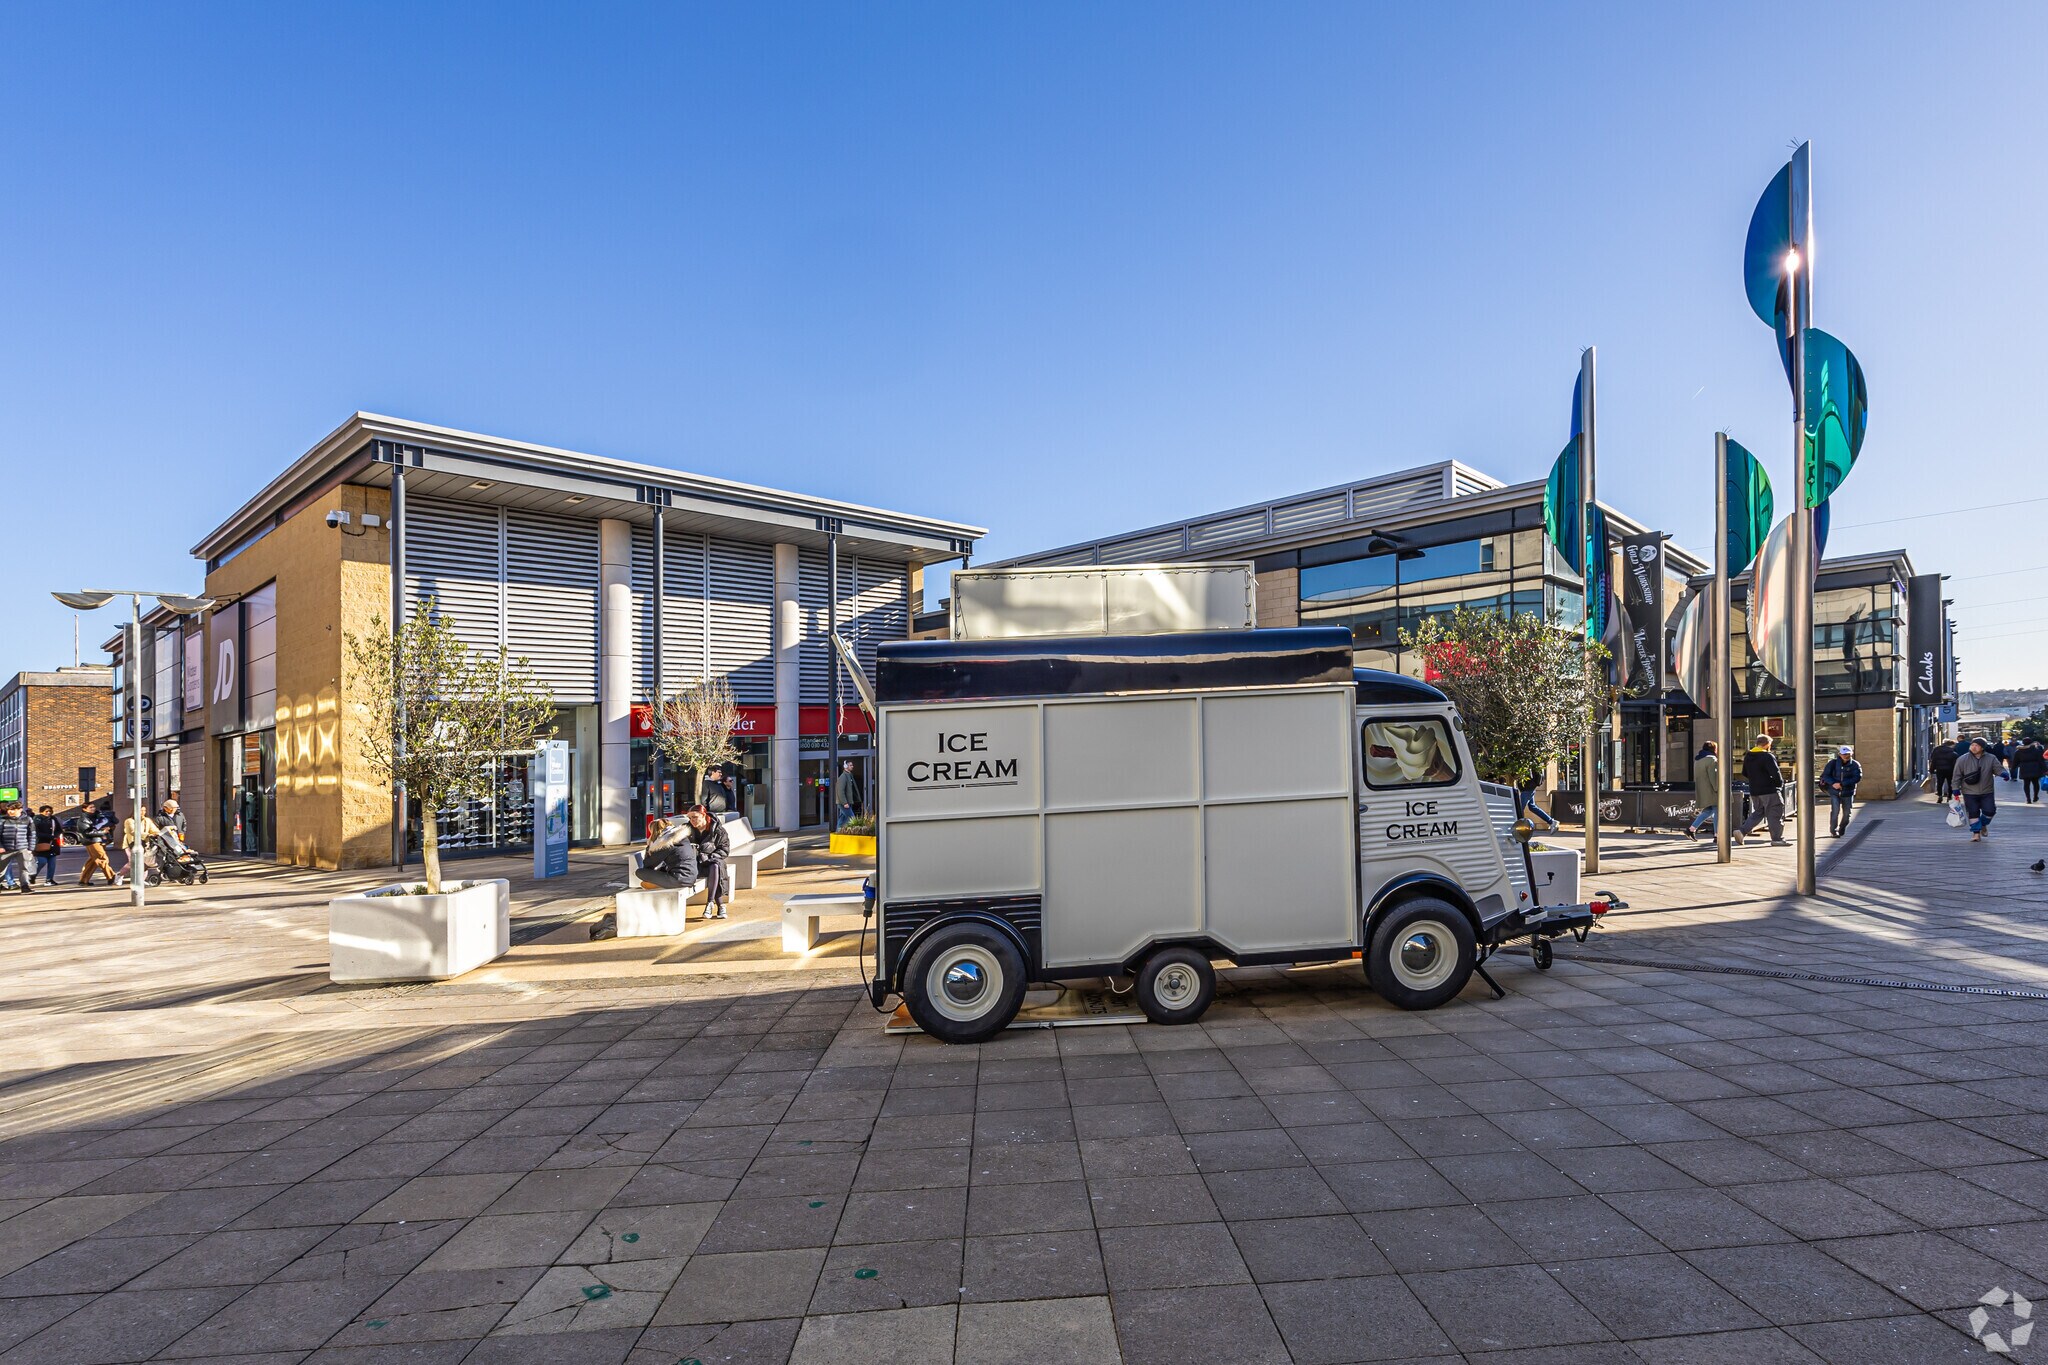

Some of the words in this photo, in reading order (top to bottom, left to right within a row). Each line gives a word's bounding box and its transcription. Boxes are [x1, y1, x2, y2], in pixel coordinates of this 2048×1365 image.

[1632, 563, 1654, 605] WORKSHOP
[213, 638, 235, 705] JD
[1917, 651, 1934, 695] Clarks
[938, 732, 988, 753] ICE
[907, 758, 1018, 782] CREAM
[1405, 800, 1438, 817] ICE
[1386, 820, 1458, 840] CREAM
